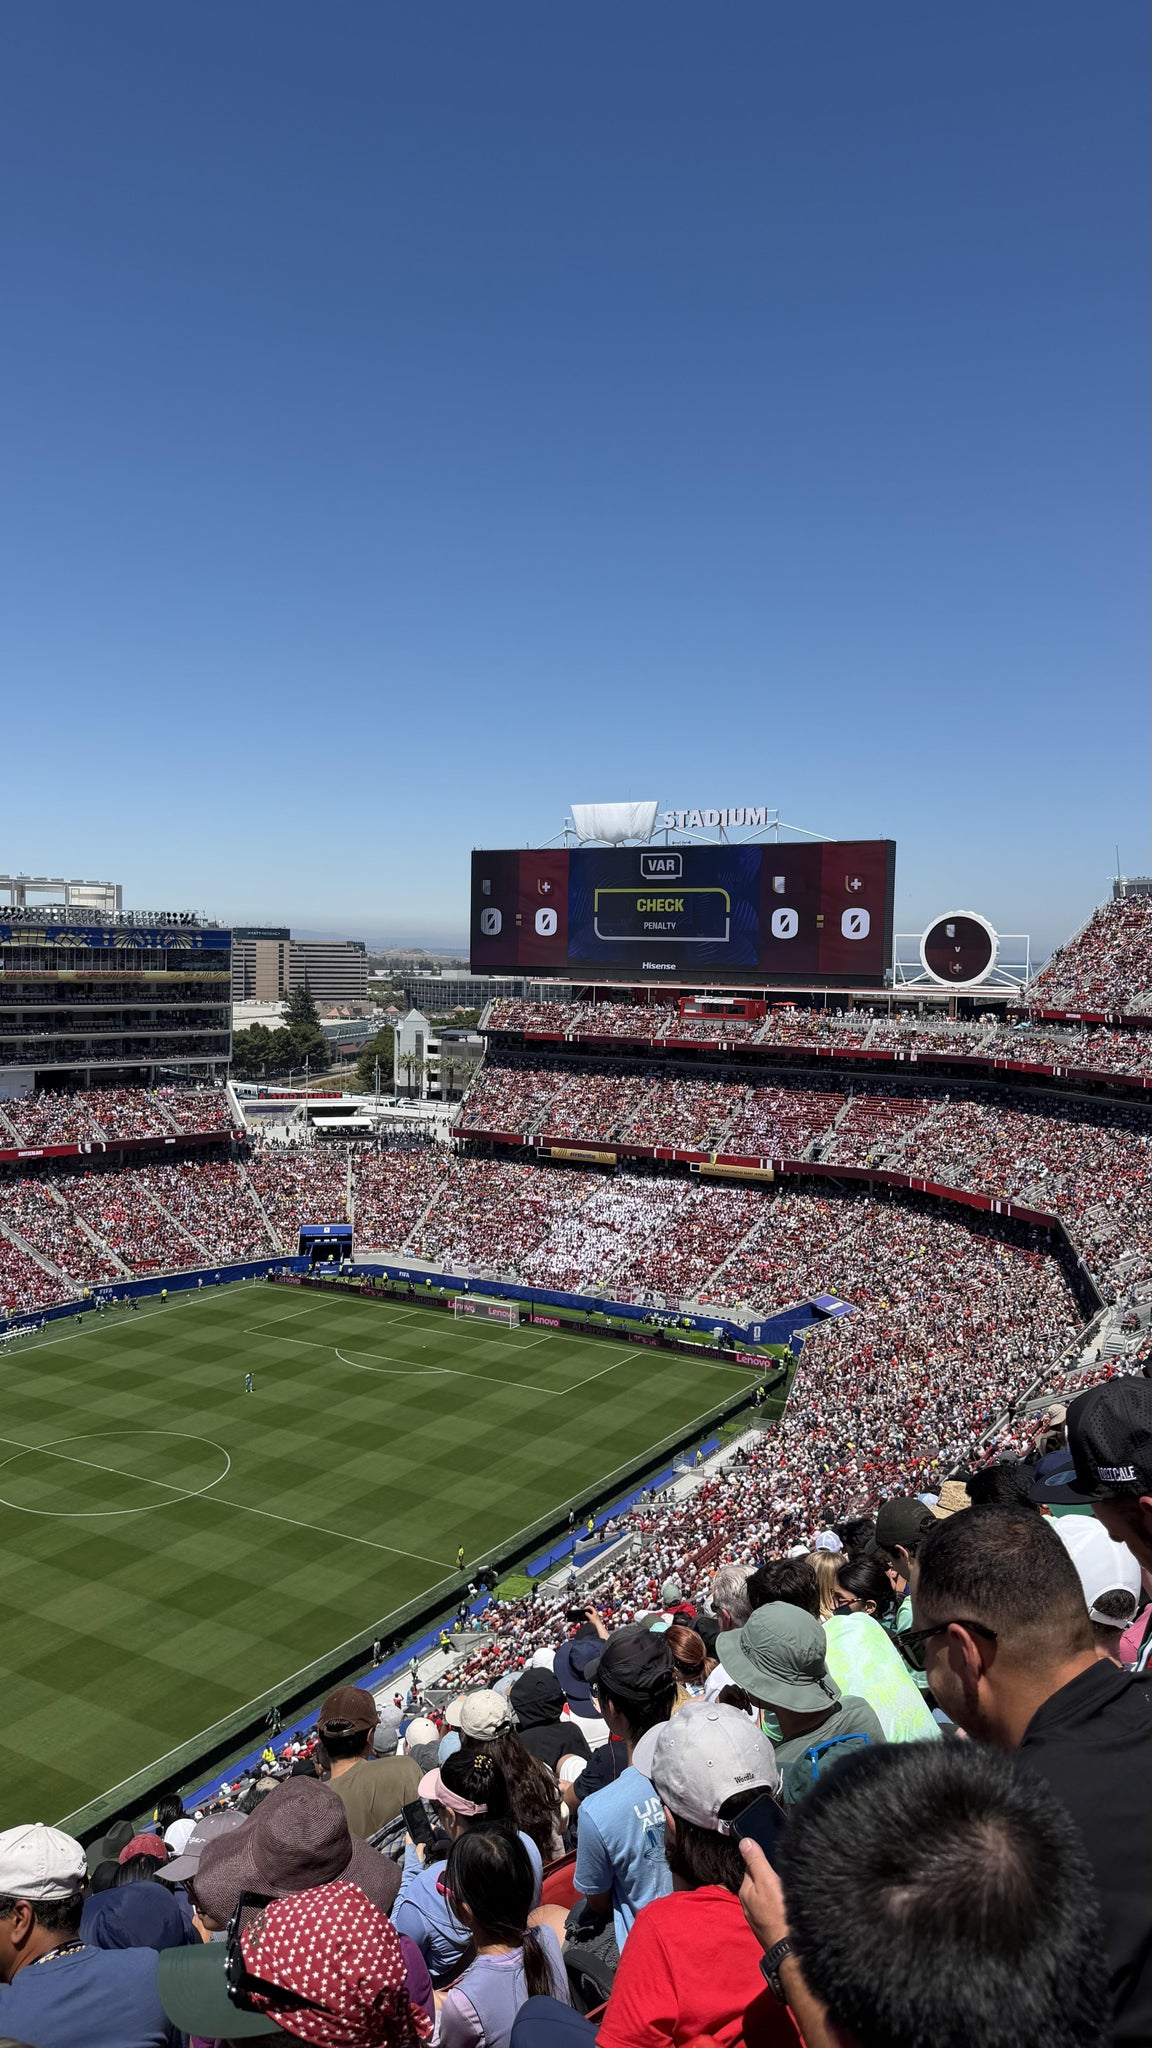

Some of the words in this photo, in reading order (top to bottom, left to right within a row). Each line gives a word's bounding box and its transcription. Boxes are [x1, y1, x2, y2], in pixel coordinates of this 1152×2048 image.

[663, 807, 767, 829] STADIUM
[648, 859, 675, 871] VAR
[636, 898, 684, 912] CHECK
[481, 908, 502, 935] 0
[535, 908, 557, 936] 0
[643, 921, 677, 930] PENALTY
[772, 908, 798, 939] 0
[842, 908, 870, 940] 0
[642, 961, 676, 970] Hisense
[274, 1275, 301, 1285] Lenovo
[736, 1353, 771, 1368] Lenovo
